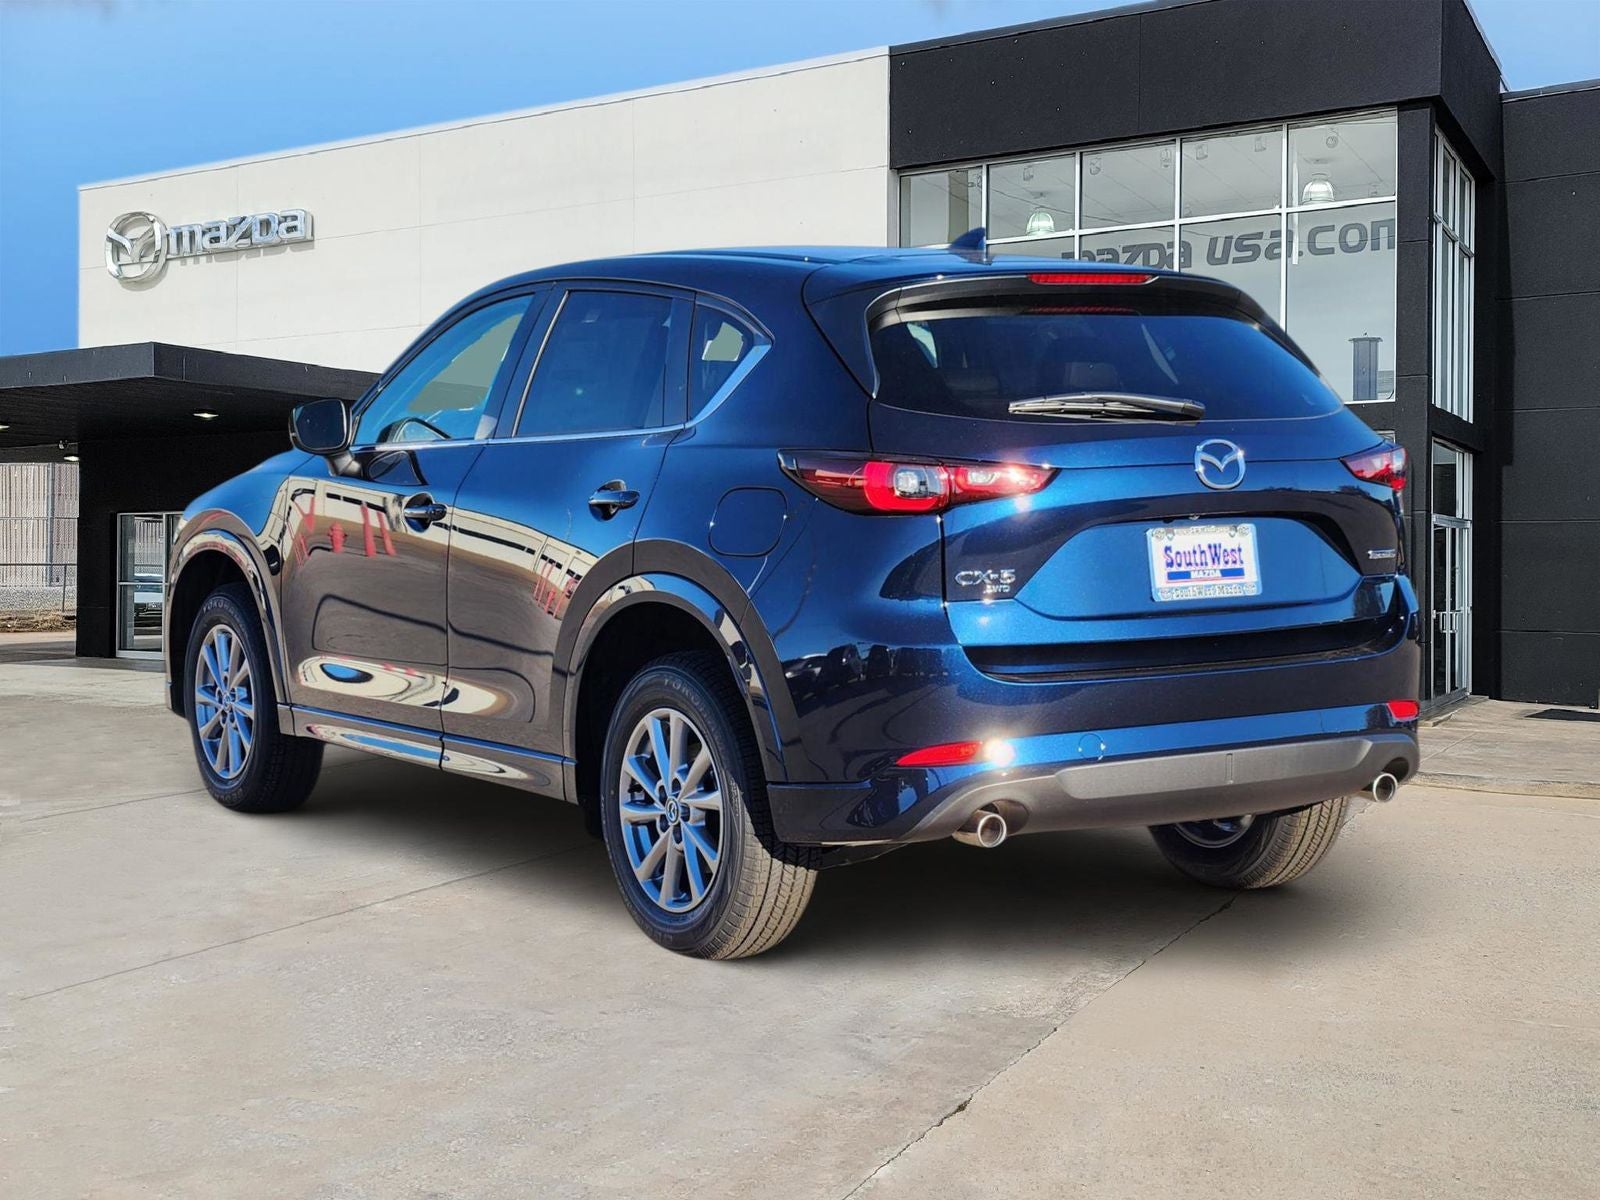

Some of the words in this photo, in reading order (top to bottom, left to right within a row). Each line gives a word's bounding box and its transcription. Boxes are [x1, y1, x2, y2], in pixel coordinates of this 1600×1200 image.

[167, 209, 311, 256] mazda
[954, 569, 1016, 586] CX-5
[1190, 569, 1222, 579] MAZDA
